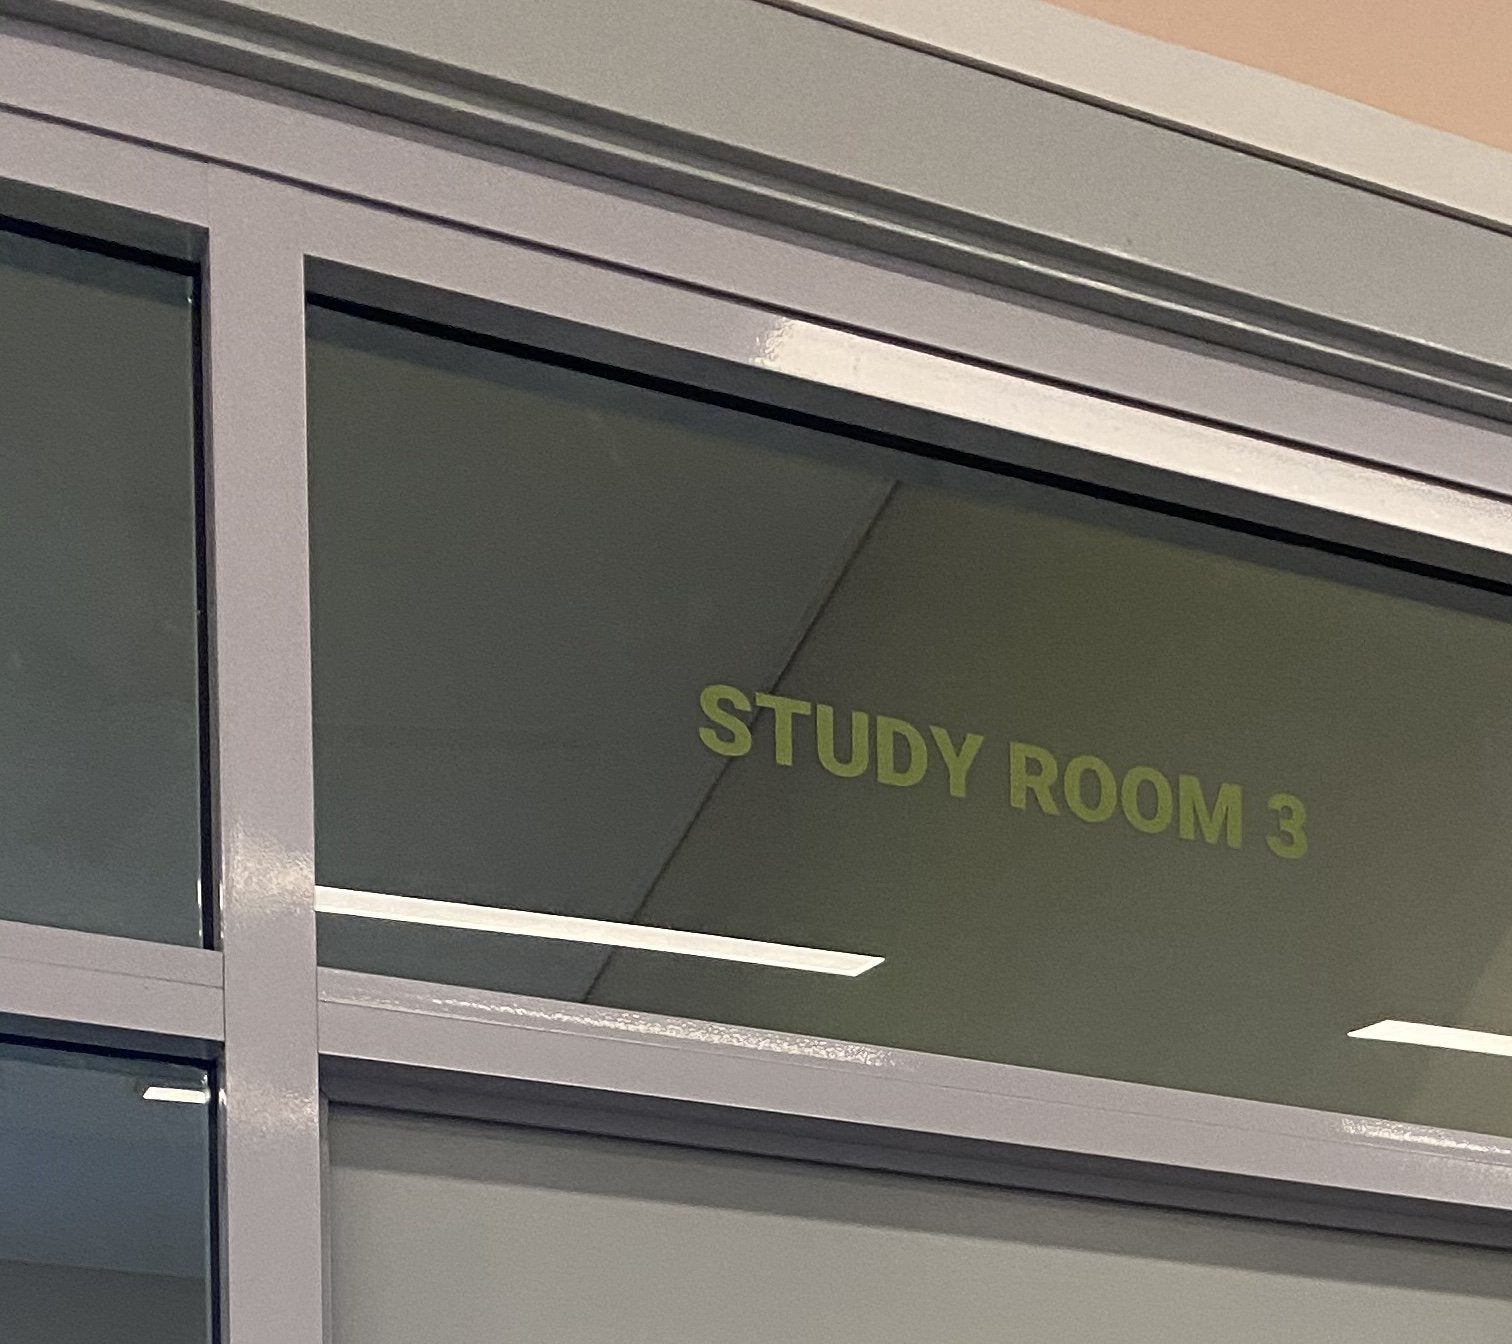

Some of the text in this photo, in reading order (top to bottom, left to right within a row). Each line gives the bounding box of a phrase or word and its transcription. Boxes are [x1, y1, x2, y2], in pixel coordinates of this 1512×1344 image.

[699, 684, 1309, 858] STUDY ROOM 3
